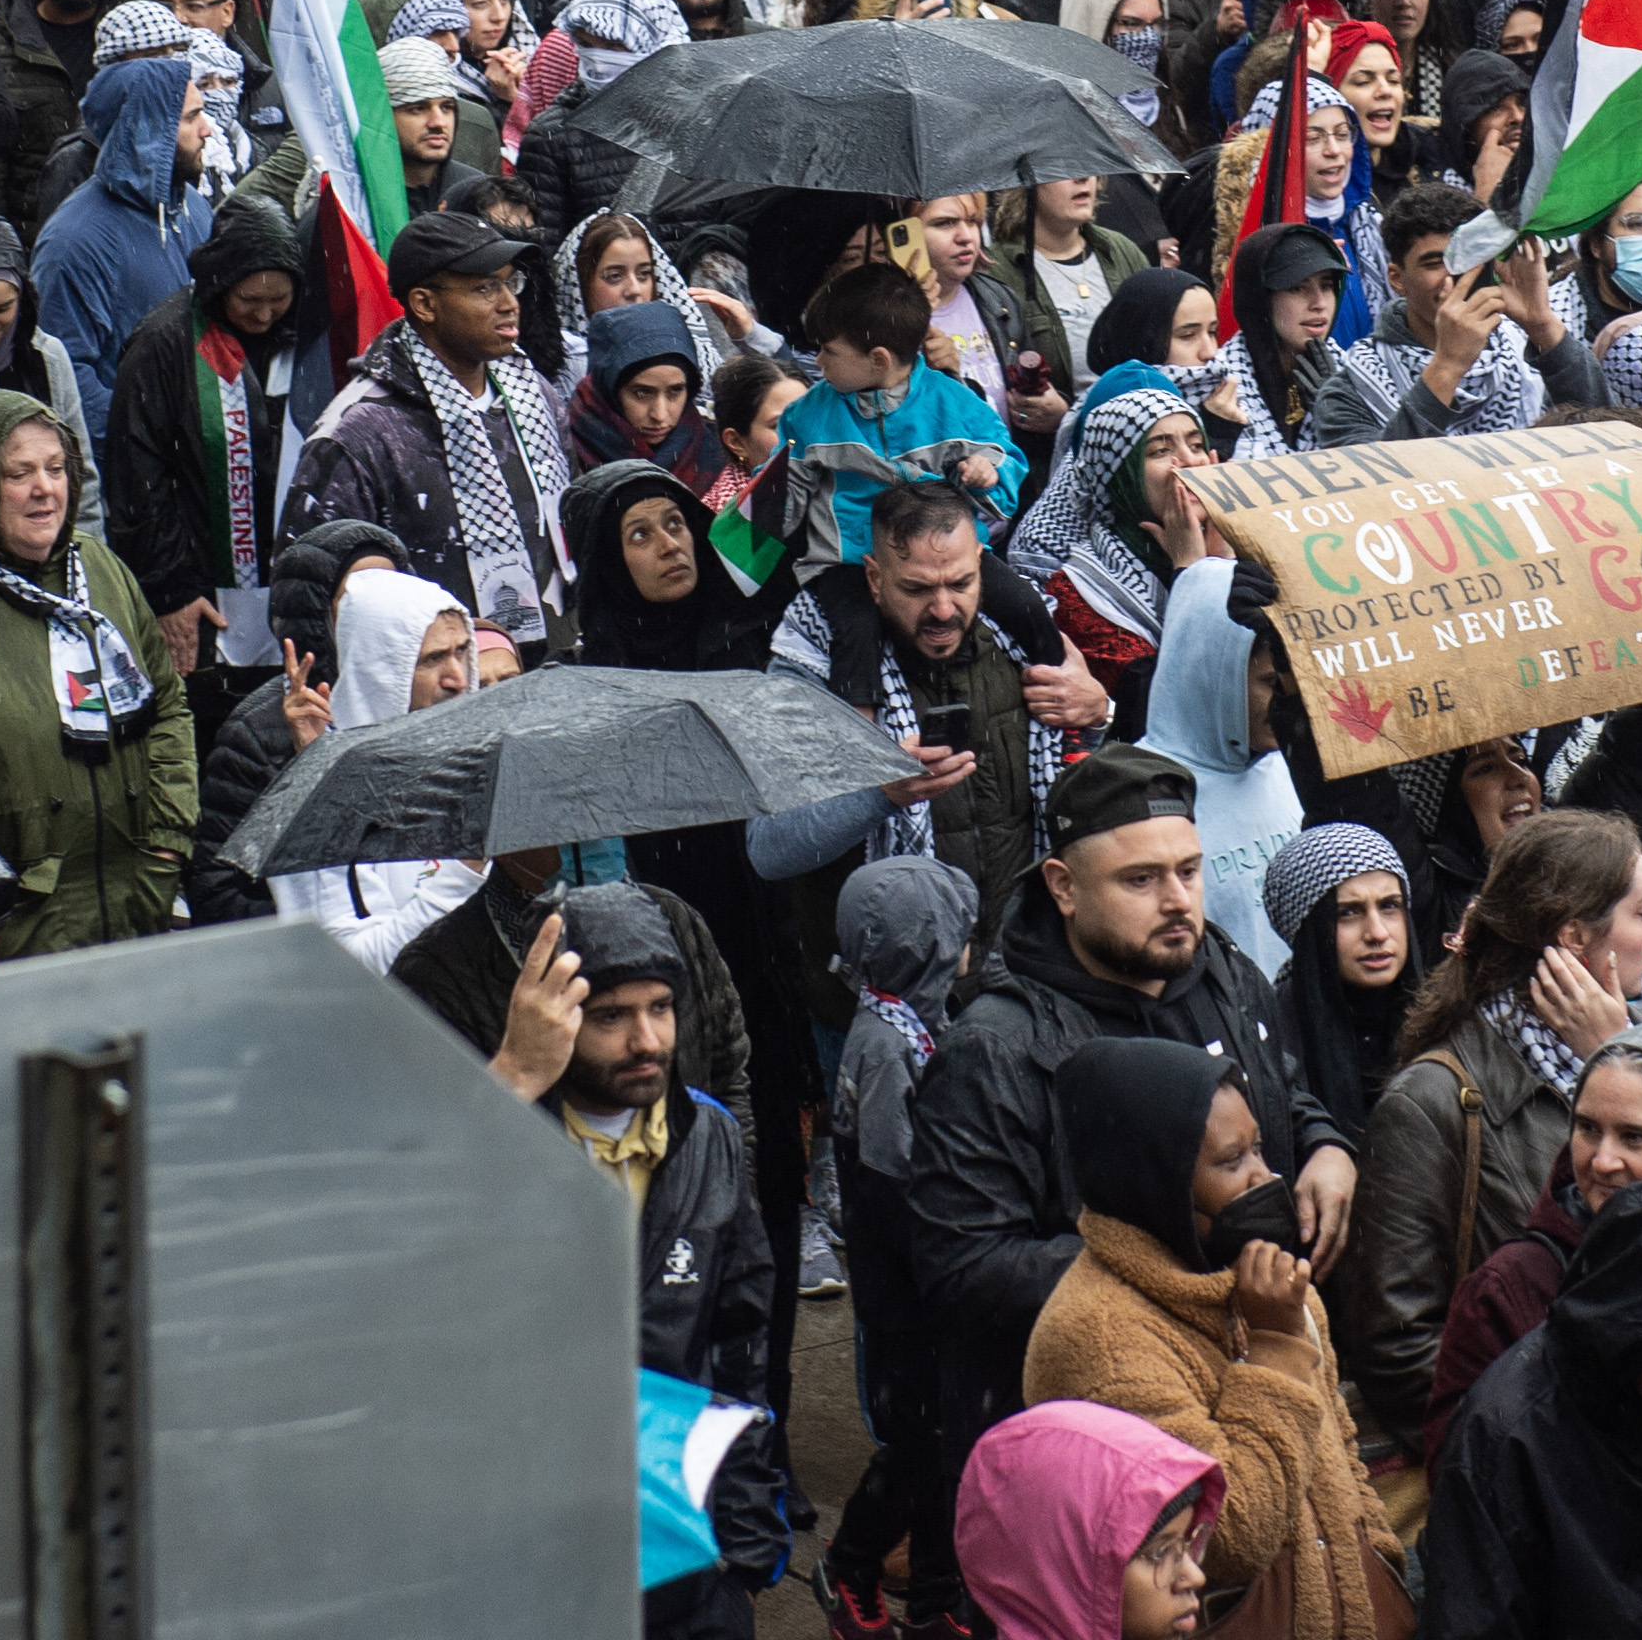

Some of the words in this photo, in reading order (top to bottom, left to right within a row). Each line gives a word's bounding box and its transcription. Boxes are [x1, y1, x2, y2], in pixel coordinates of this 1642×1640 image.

[226, 409, 255, 564] PALESTINE
[1182, 441, 1414, 514] WHEN
[1272, 499, 1355, 534] YOU
[1390, 480, 1465, 512] GET
[1605, 457, 1634, 477] A
[1284, 571, 1503, 643] PROTECTED
[1526, 558, 1567, 590] BY
[1311, 629, 1415, 681] WILL
[1430, 596, 1563, 652] NEVER
[1408, 680, 1456, 719] BE
[1210, 829, 1301, 884] PRAD
